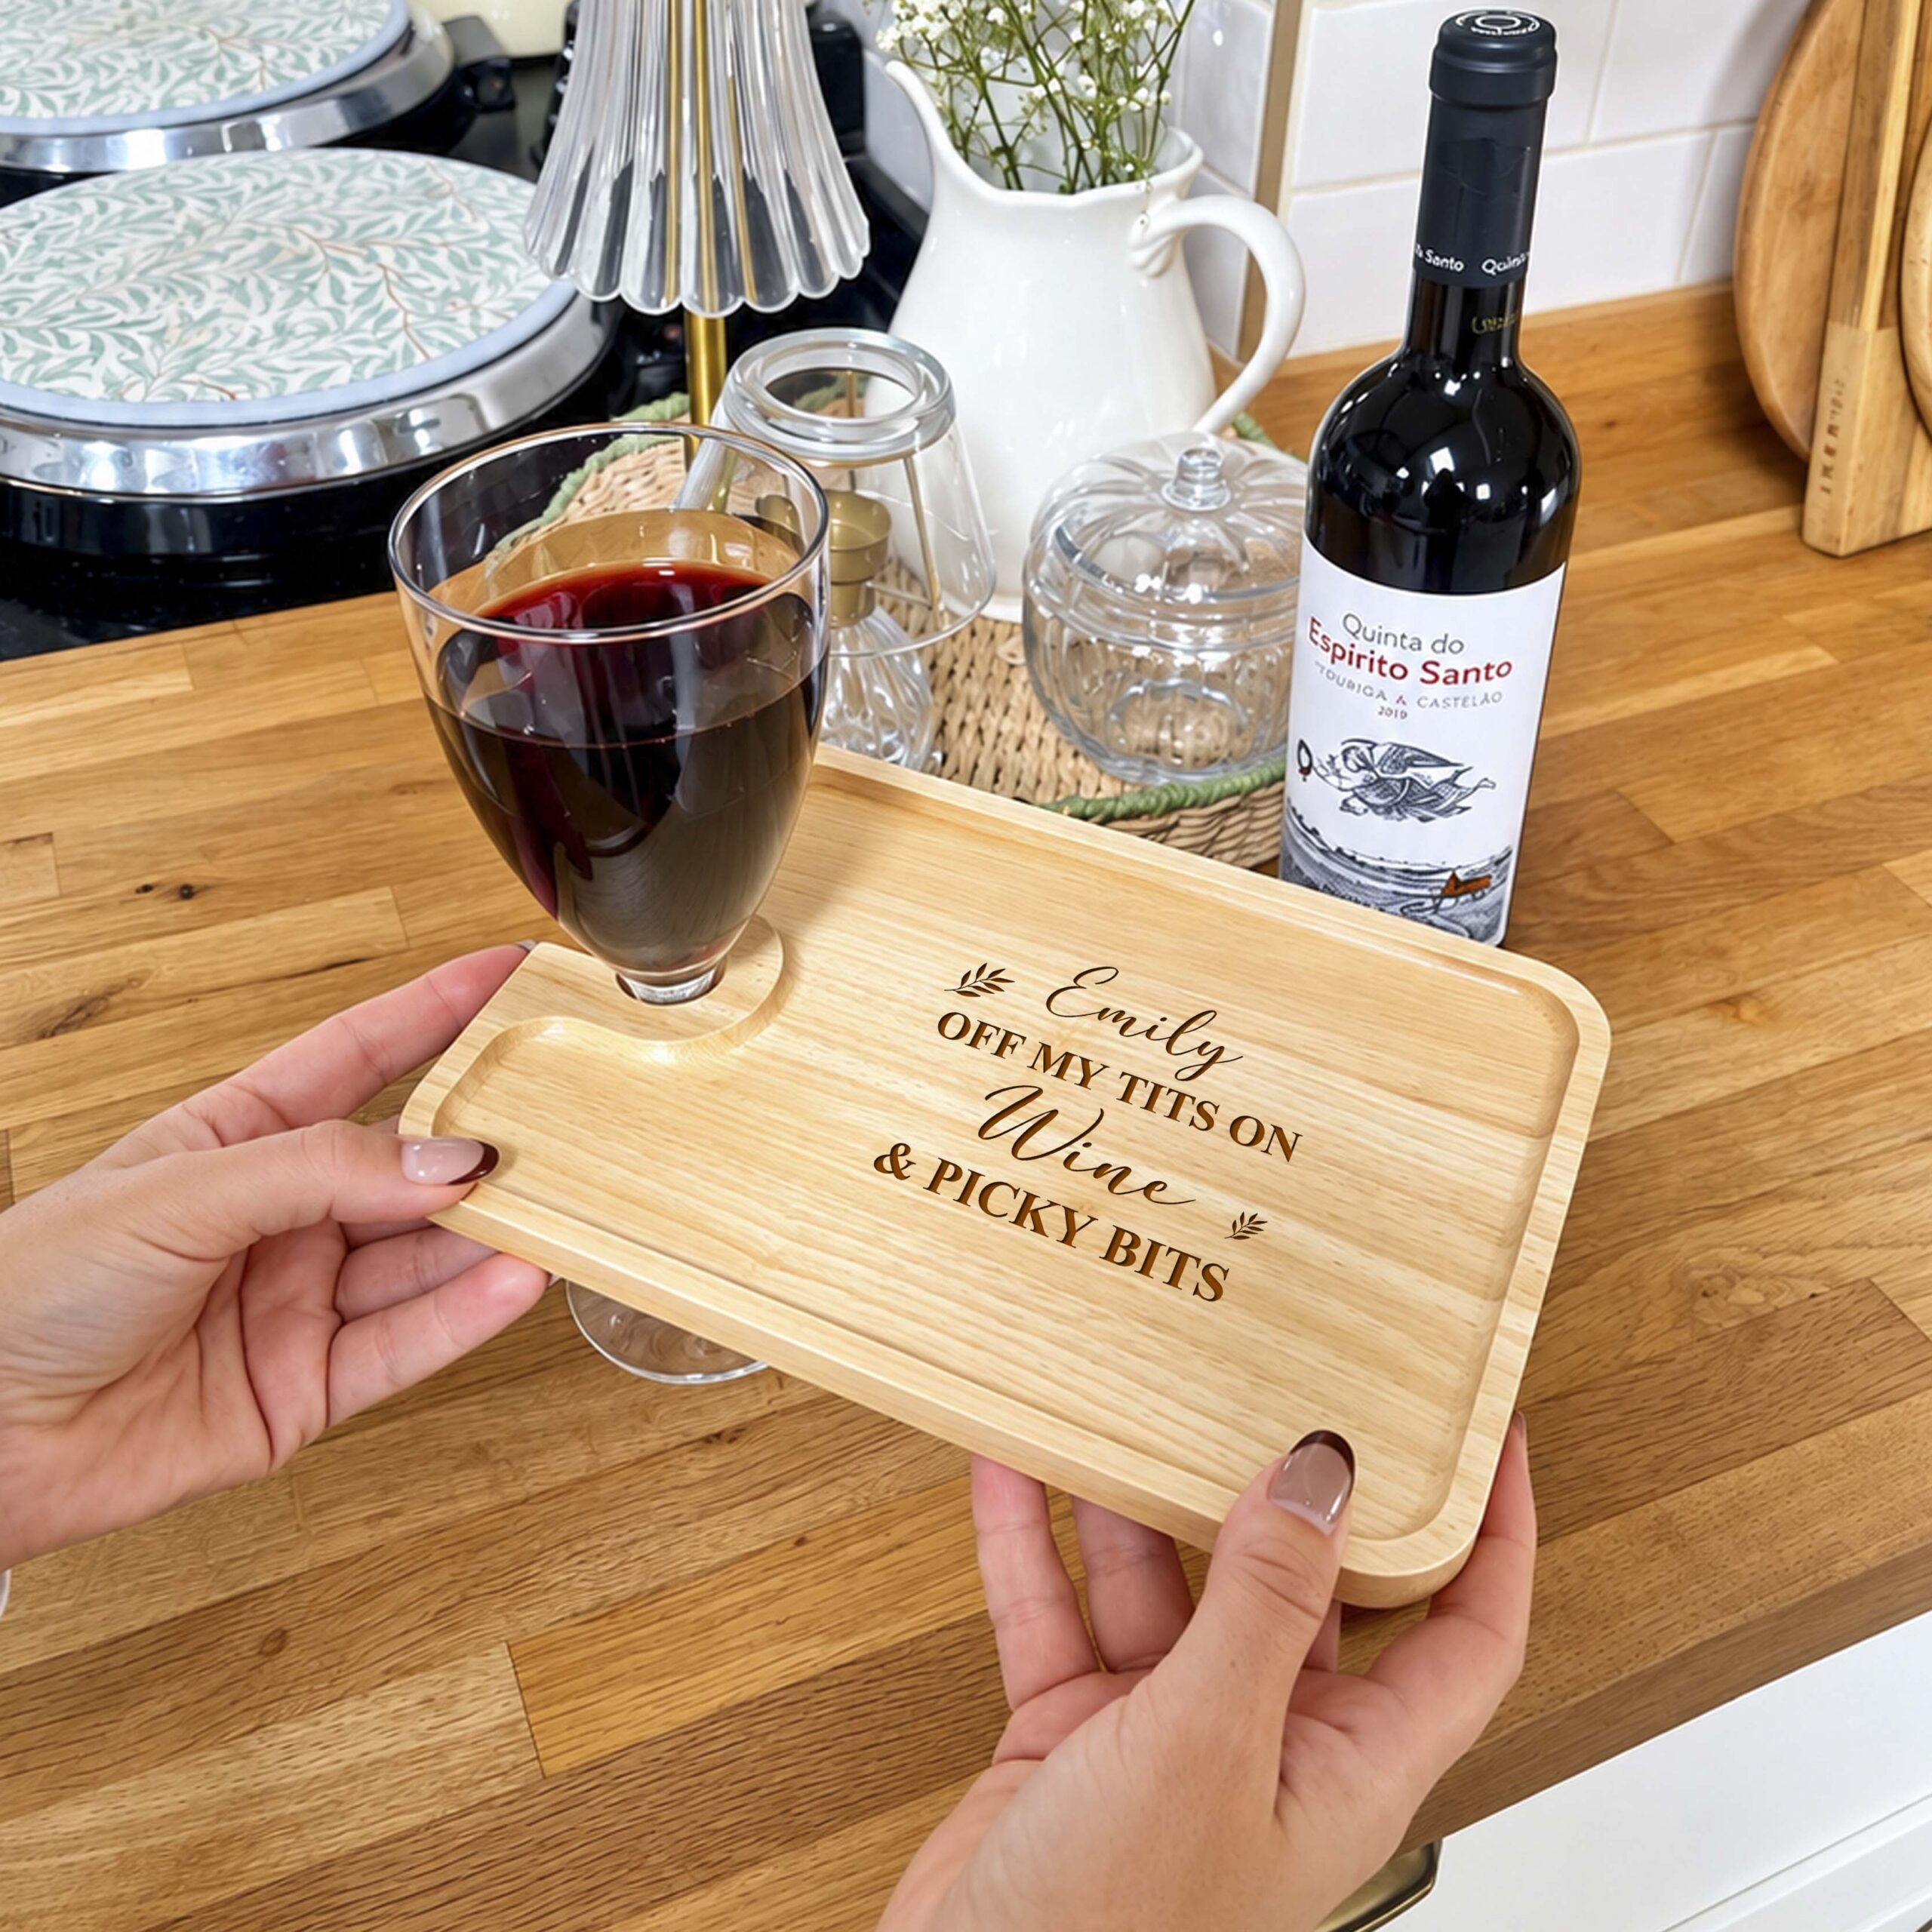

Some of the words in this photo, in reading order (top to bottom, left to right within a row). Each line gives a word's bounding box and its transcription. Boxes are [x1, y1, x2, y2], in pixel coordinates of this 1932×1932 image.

[1424, 248, 1465, 272] Santo
[1309, 616, 1409, 680] Espirito
[1420, 660, 1513, 685] Santo
[1343, 613, 1423, 652] Quinta
[1431, 633, 1465, 655] do
[1045, 966, 1244, 1081] Emily
[937, 1011, 1027, 1060] OFF
[1027, 1041, 1110, 1091] MY
[1116, 1071, 1220, 1131] TITS
[1229, 1115, 1303, 1163] ON
[978, 1084, 1197, 1205] Wine
[873, 1143, 917, 1181] &
[922, 1158, 1100, 1249] PICKY
[1099, 1225, 1230, 1303] BITS
